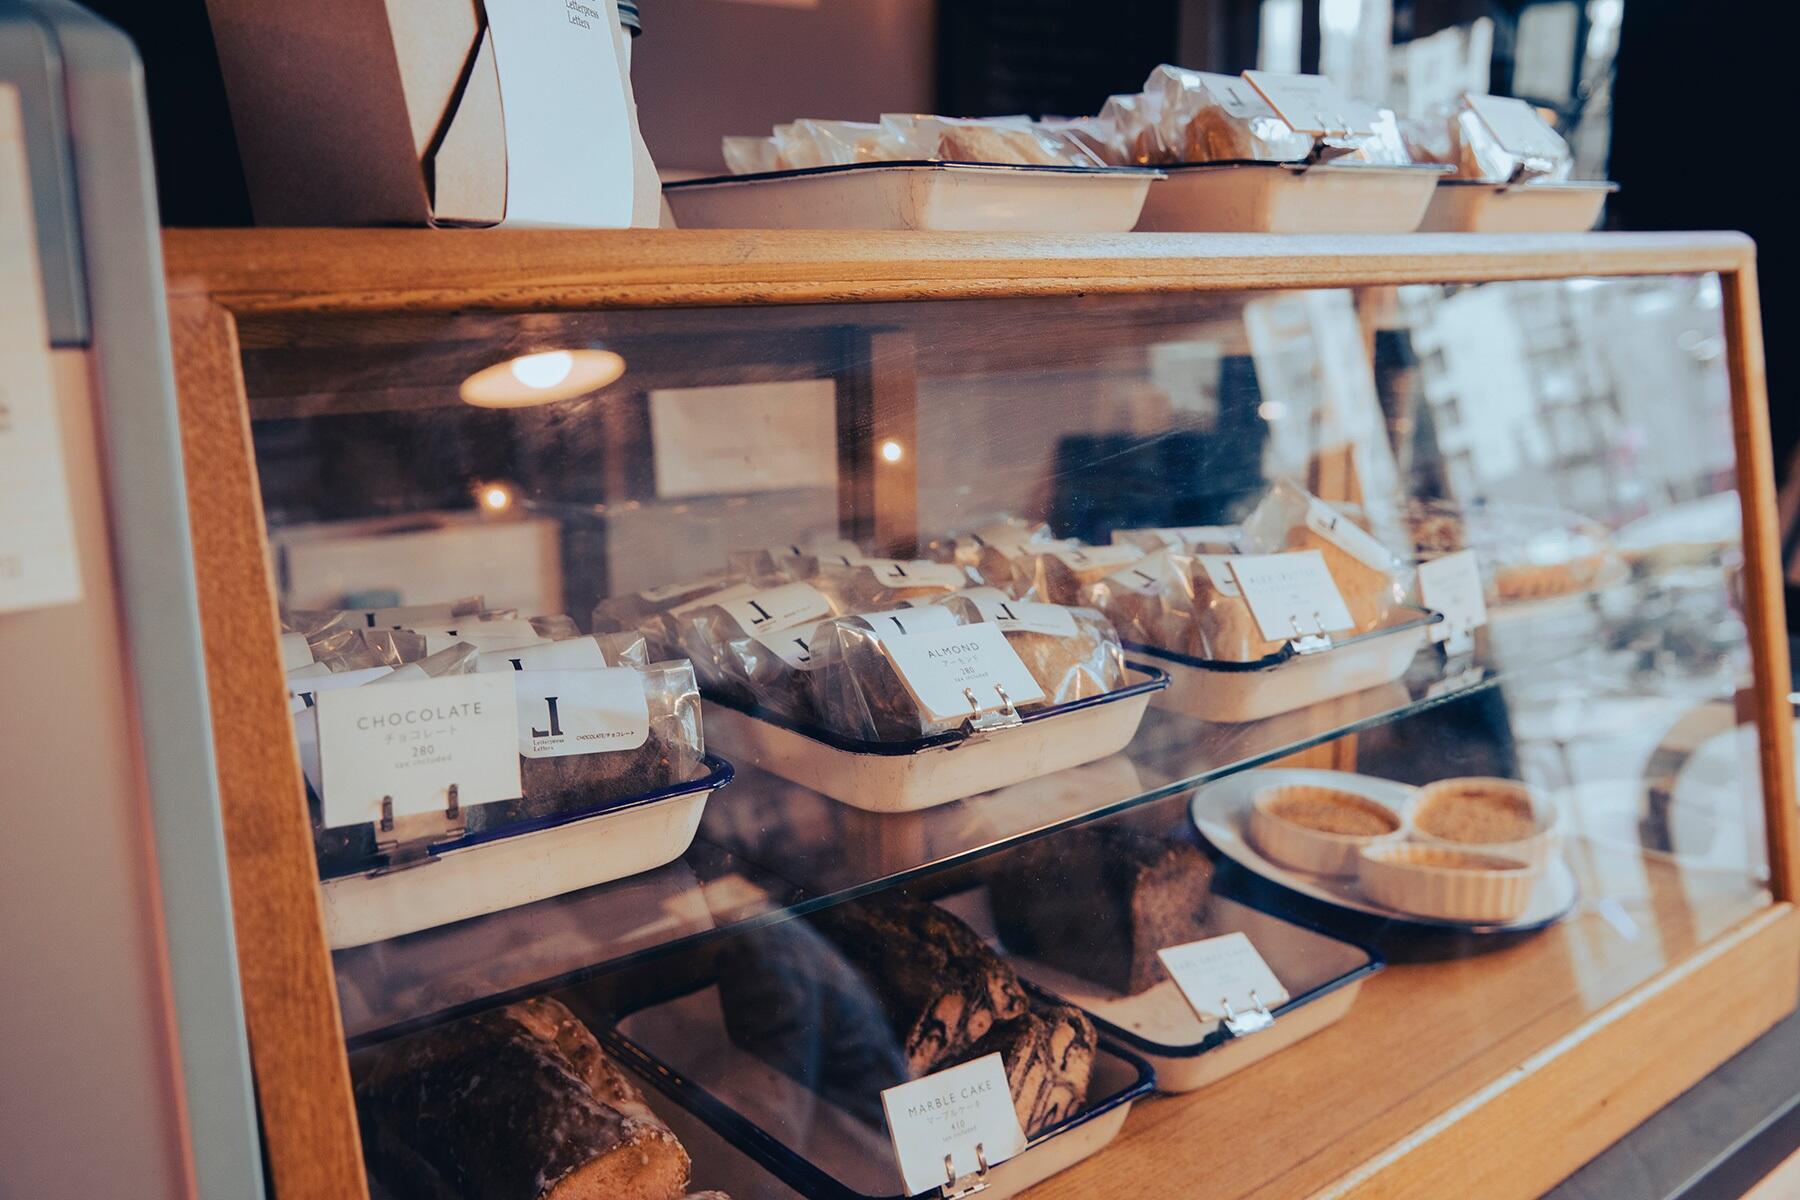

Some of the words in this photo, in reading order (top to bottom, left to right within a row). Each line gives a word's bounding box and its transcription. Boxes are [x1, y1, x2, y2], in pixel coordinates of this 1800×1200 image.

[567, 10, 590, 30] Letters
[928, 642, 980, 659] ALMOND
[357, 702, 482, 730] CHOCOLATE
[384, 724, 458, 746] チョコレート
[411, 745, 435, 758] 280
[908, 1092, 956, 1118] MARBLE
[961, 1079, 993, 1100] CAKE
